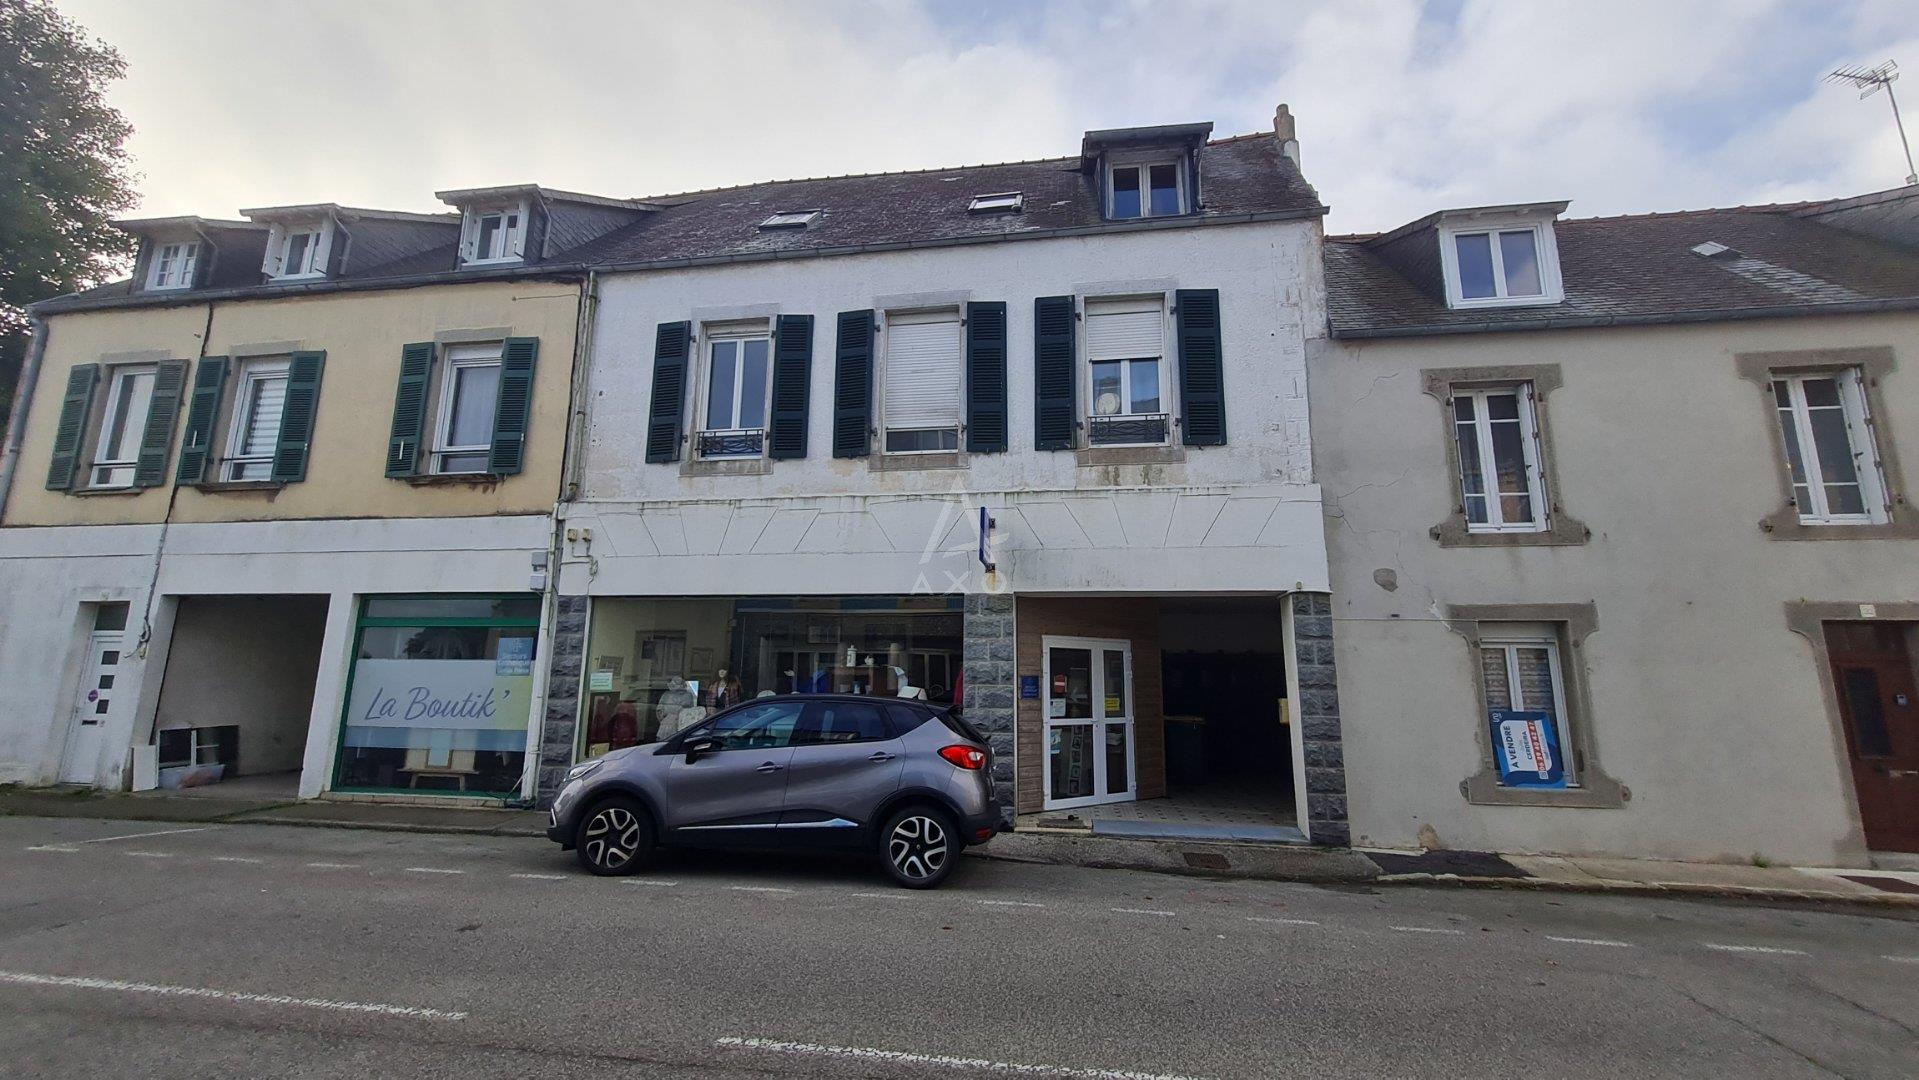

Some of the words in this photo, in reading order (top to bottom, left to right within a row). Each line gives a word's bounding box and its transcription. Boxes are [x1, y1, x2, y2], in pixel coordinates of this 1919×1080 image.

[365, 687, 397, 720] La
[404, 686, 510, 721] Boutik'
[1503, 725, 1517, 760] VENDRE
